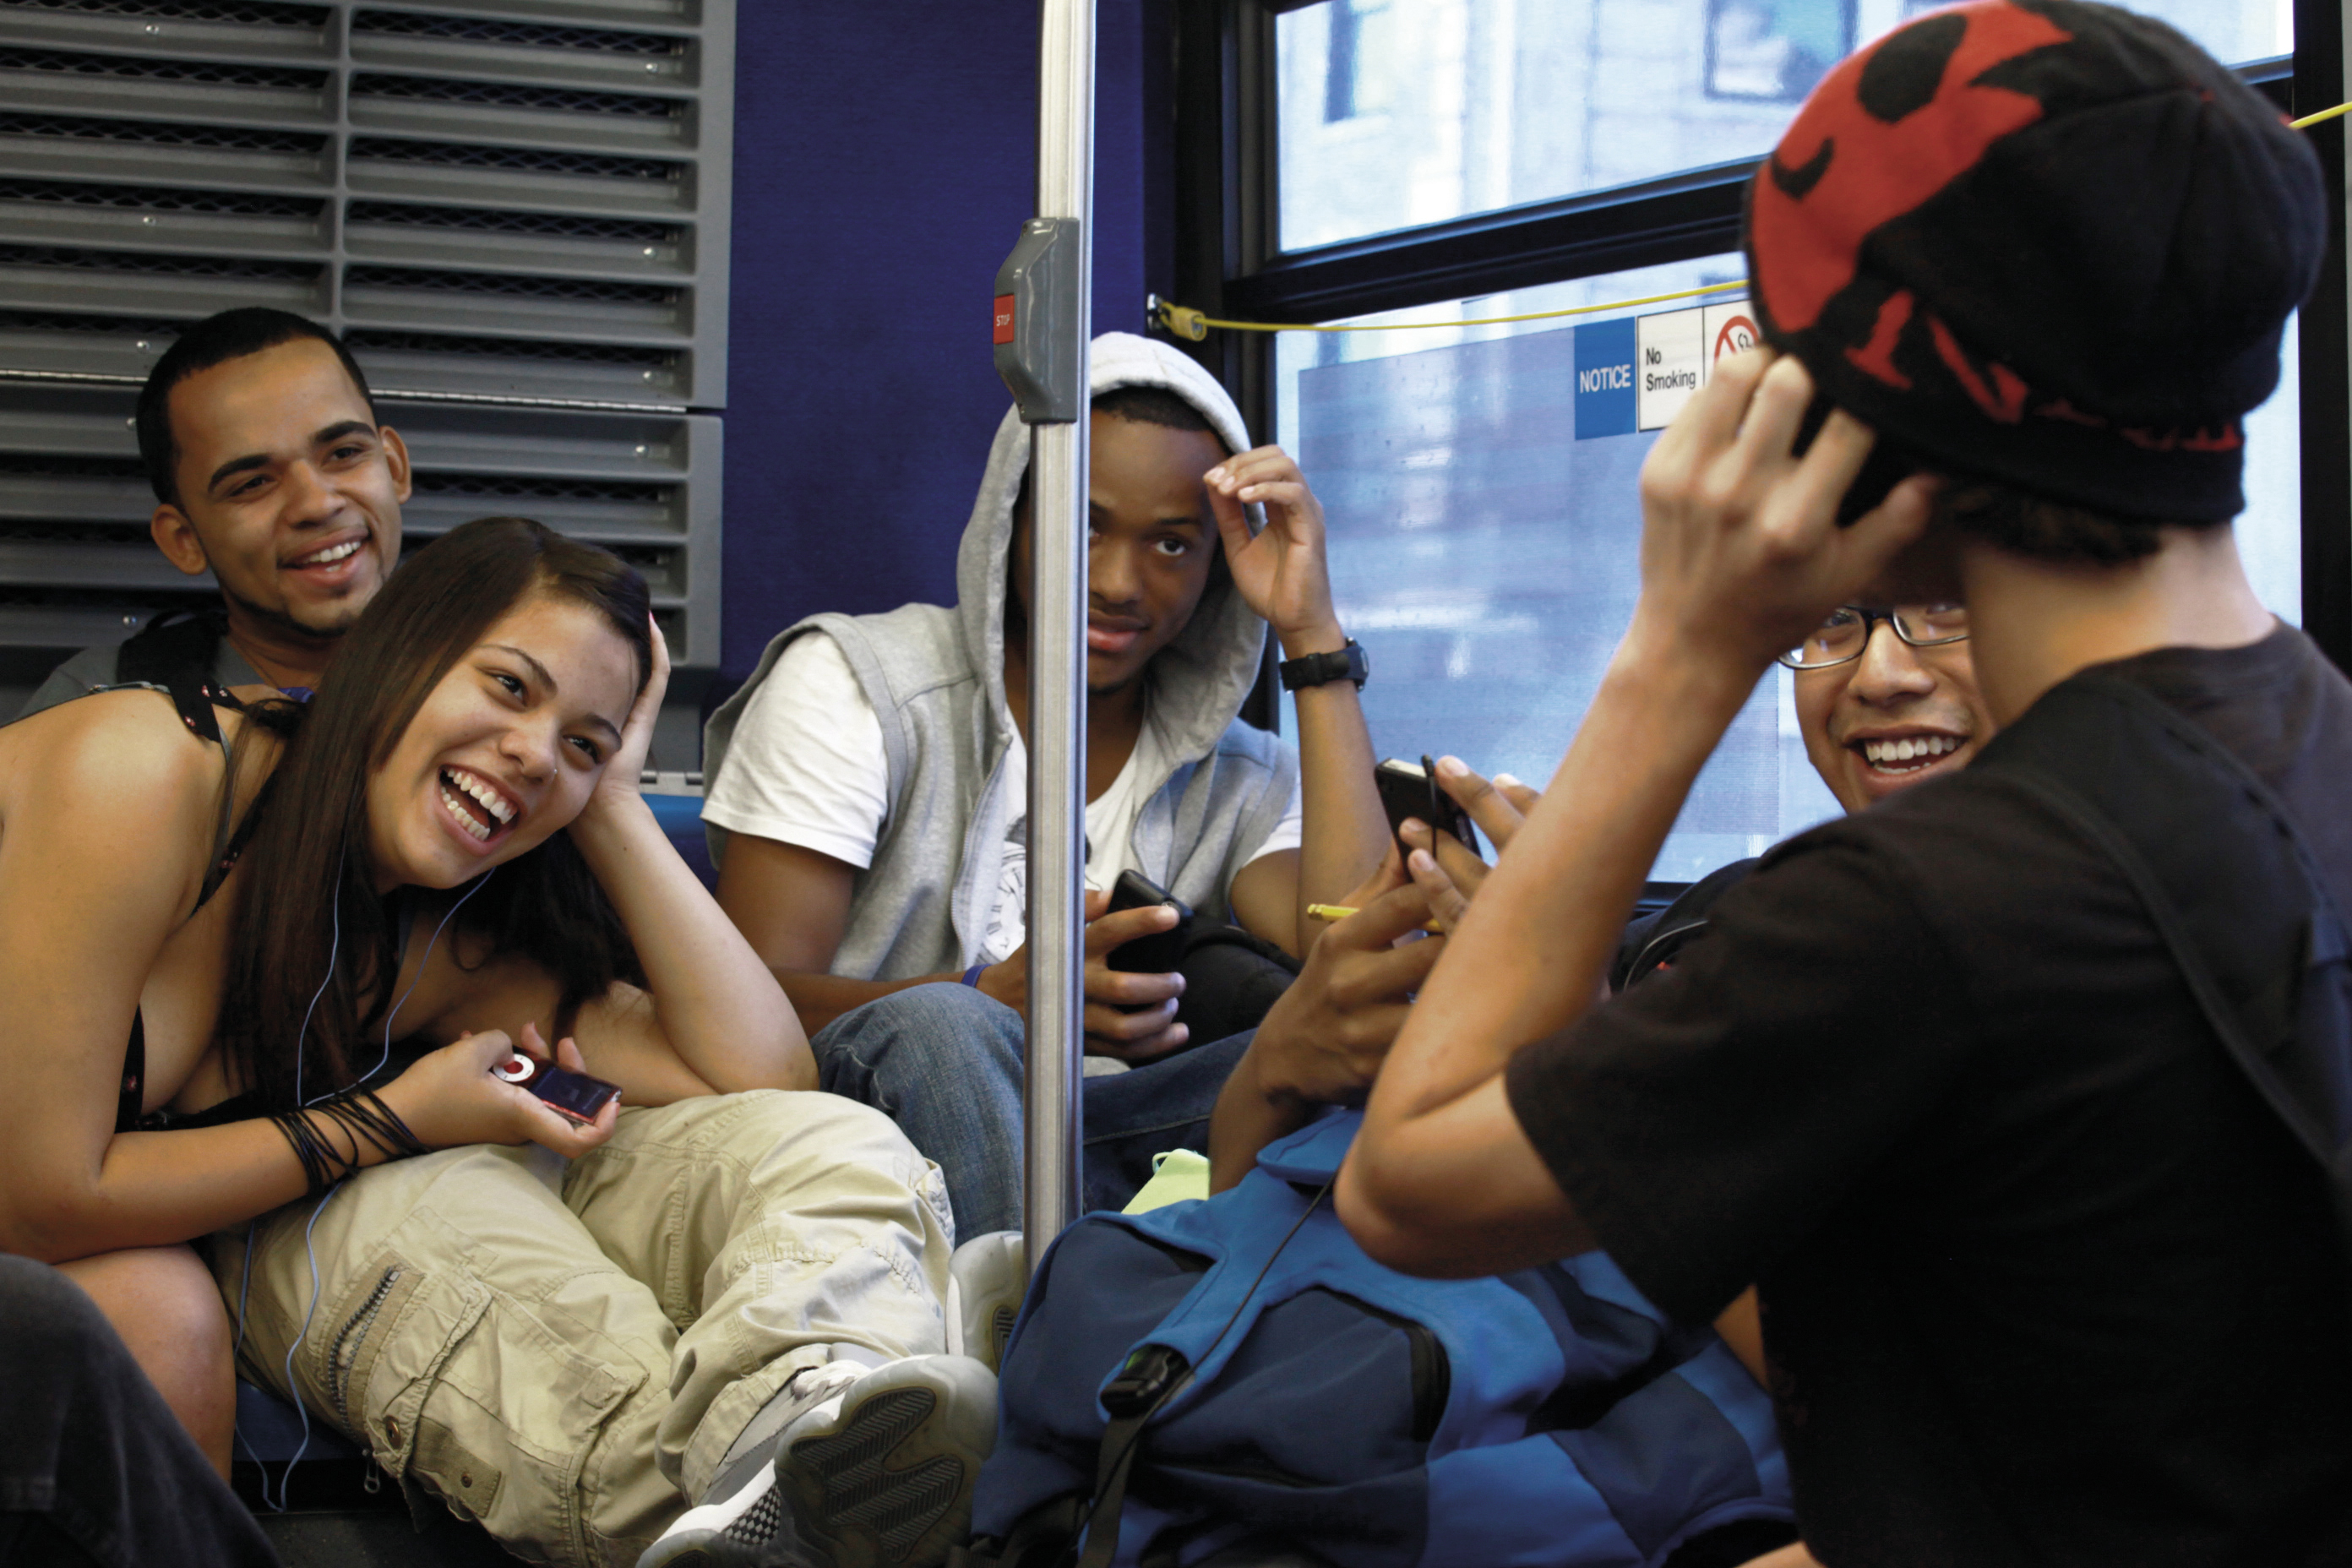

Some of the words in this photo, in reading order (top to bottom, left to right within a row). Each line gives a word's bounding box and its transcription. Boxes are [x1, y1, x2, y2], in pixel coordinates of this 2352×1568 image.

[996, 313, 1010, 327] STOP
[1646, 347, 1662, 366] No
[1580, 364, 1631, 394] NOTICE
[1646, 369, 1696, 391] Smoking
